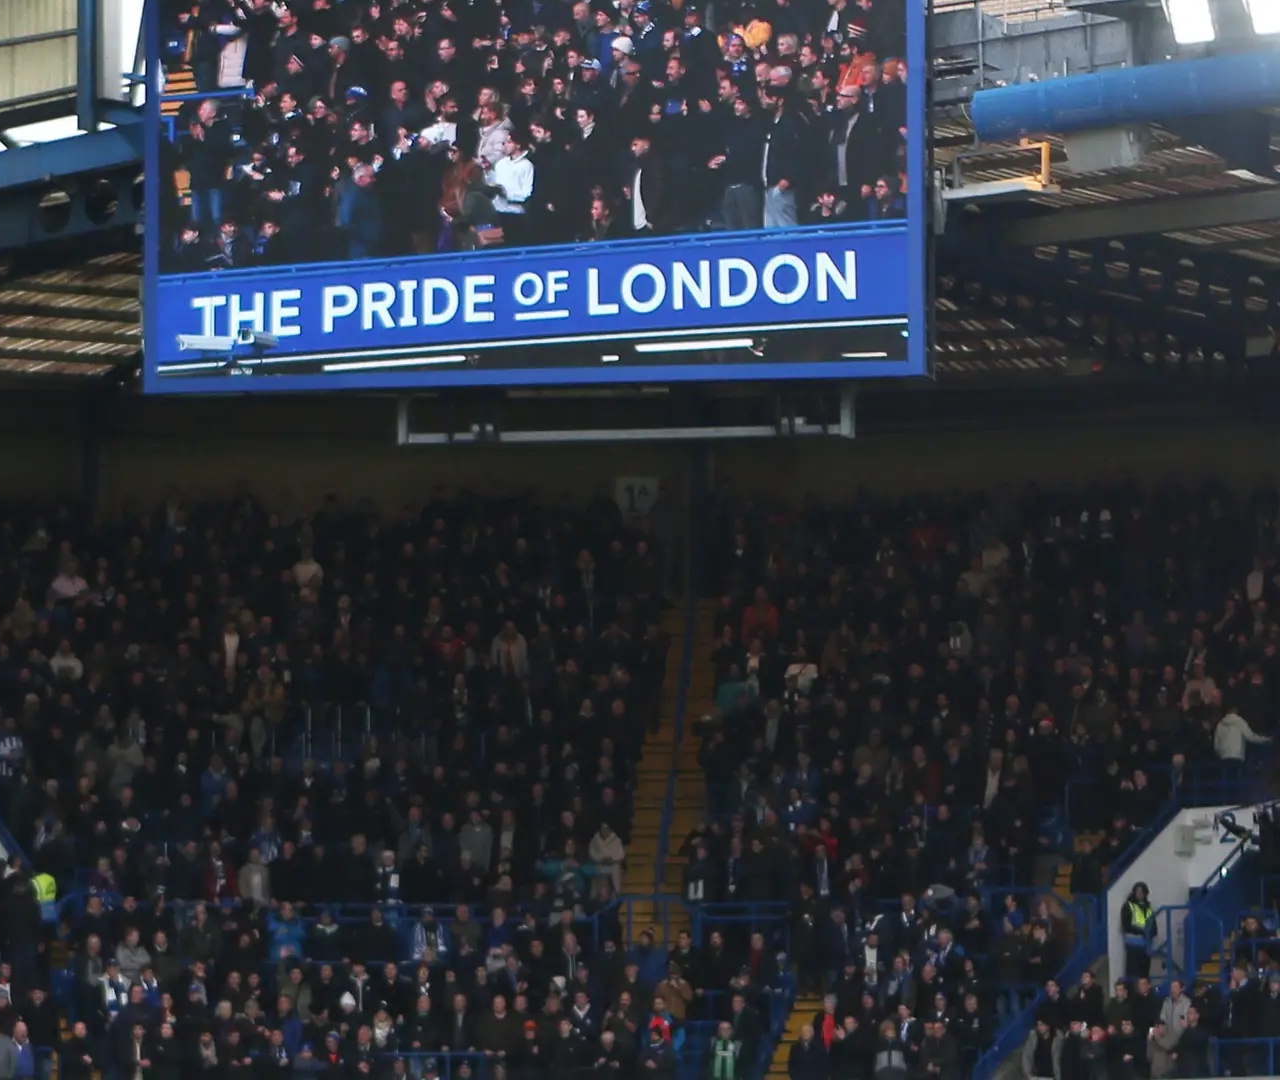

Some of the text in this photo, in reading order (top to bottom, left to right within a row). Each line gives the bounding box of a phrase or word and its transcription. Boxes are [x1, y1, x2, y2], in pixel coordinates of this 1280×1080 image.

[192, 250, 858, 339] THE PRIDE OF LONDON
[1219, 810, 1237, 843] 2
